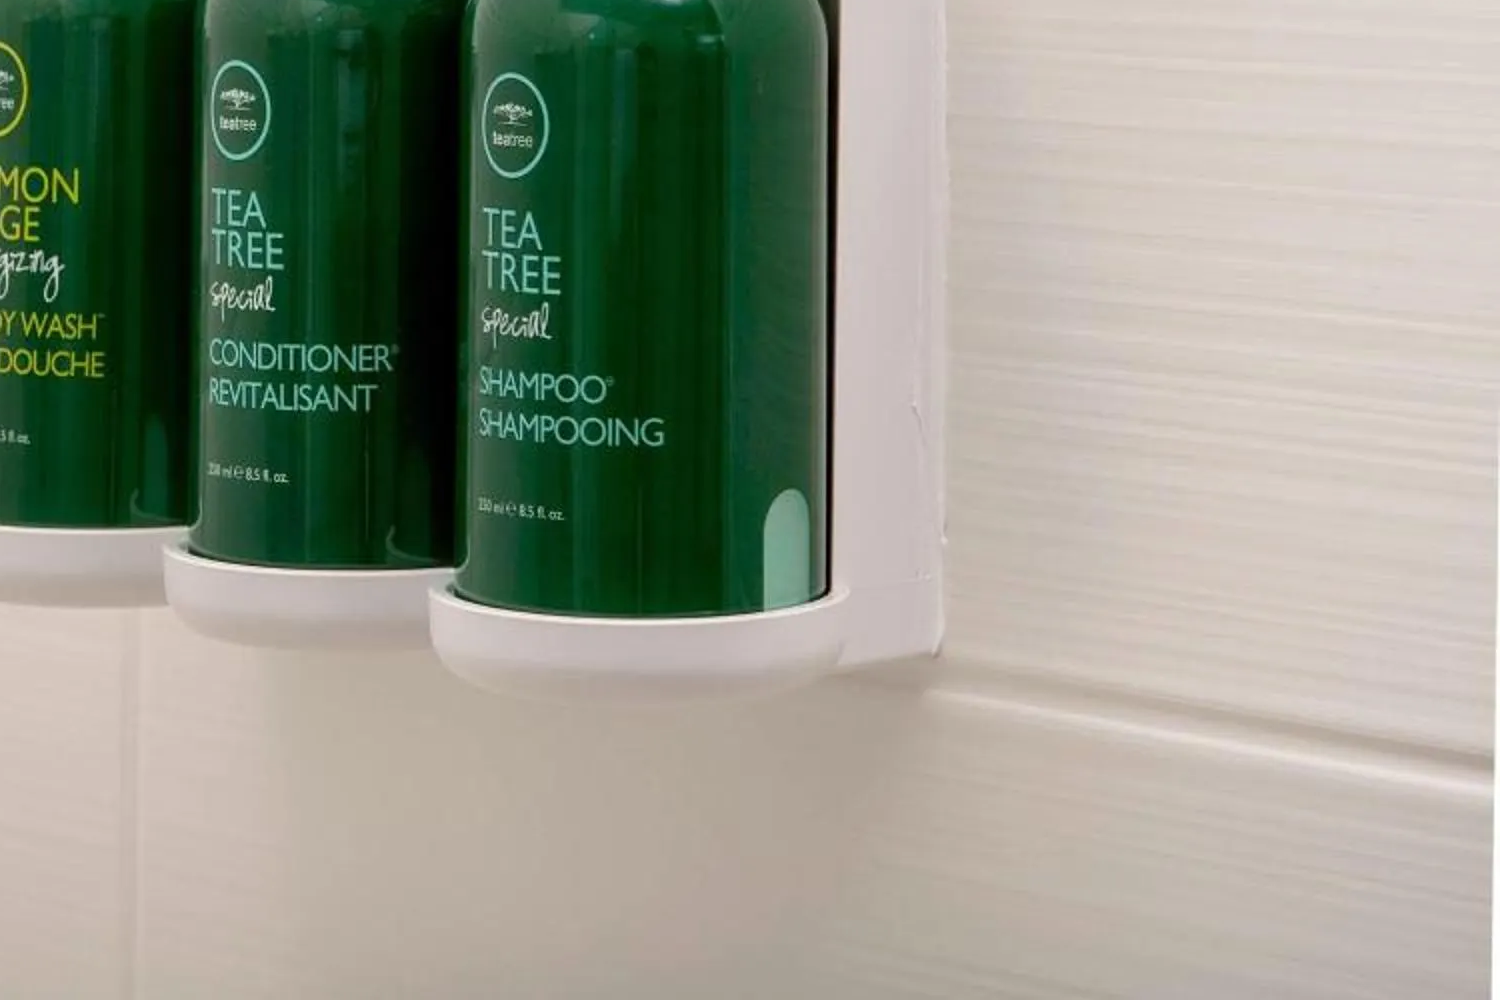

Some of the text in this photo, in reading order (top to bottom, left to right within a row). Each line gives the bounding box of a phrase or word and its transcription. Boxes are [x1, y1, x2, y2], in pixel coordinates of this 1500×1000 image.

[219, 115, 257, 131] teatree
[492, 130, 534, 148] teatree
[211, 187, 267, 229] TEA
[483, 206, 543, 251] TEA
[211, 227, 285, 270] TREE
[481, 249, 562, 294] TREE
[209, 275, 277, 323] special
[20, 311, 98, 340] WASH
[481, 301, 553, 350] special
[208, 376, 379, 413] REVITALISANT
[479, 407, 666, 447] SHAMPOOING
